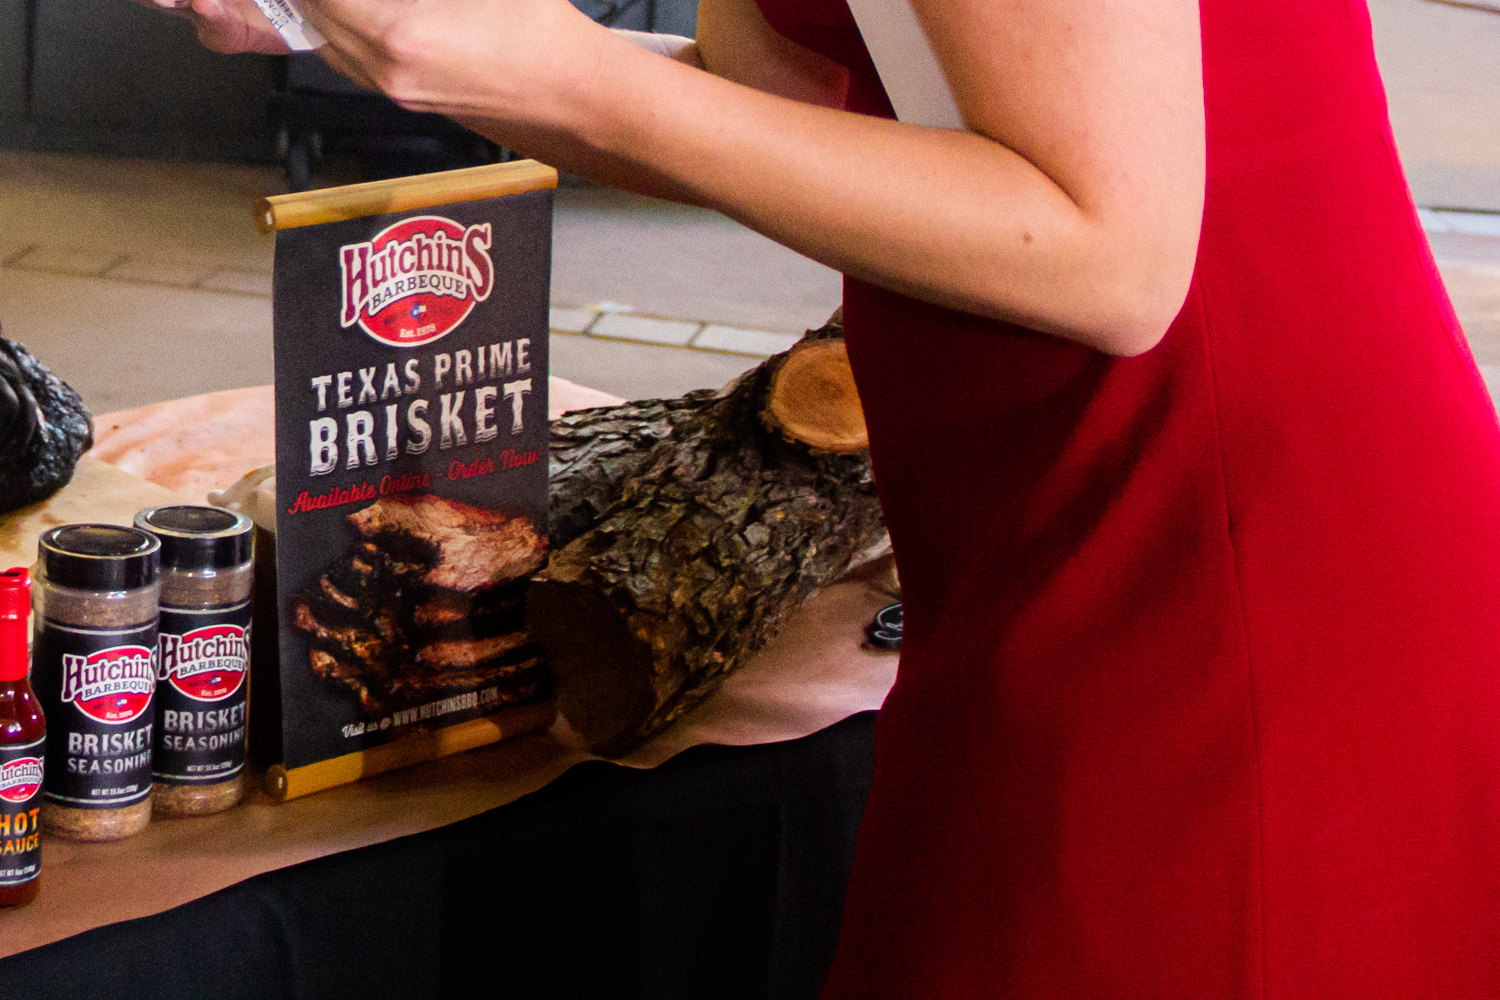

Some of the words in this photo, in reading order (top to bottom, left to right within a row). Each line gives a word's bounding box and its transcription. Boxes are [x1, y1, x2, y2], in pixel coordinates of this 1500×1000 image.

[371, 274, 464, 310] BARBEQUE
[311, 358, 421, 412] TEXAS
[433, 337, 532, 391] PRIME
[309, 378, 533, 476] BRISKET
[288, 482, 377, 515] Available
[448, 457, 495, 481] Order
[180, 659, 243, 676] BARBEQUE
[85, 681, 150, 698] BARBEQUE
[164, 701, 245, 733] BRISKET
[341, 722, 366, 738] Visit
[68, 724, 152, 755] BRISKET
